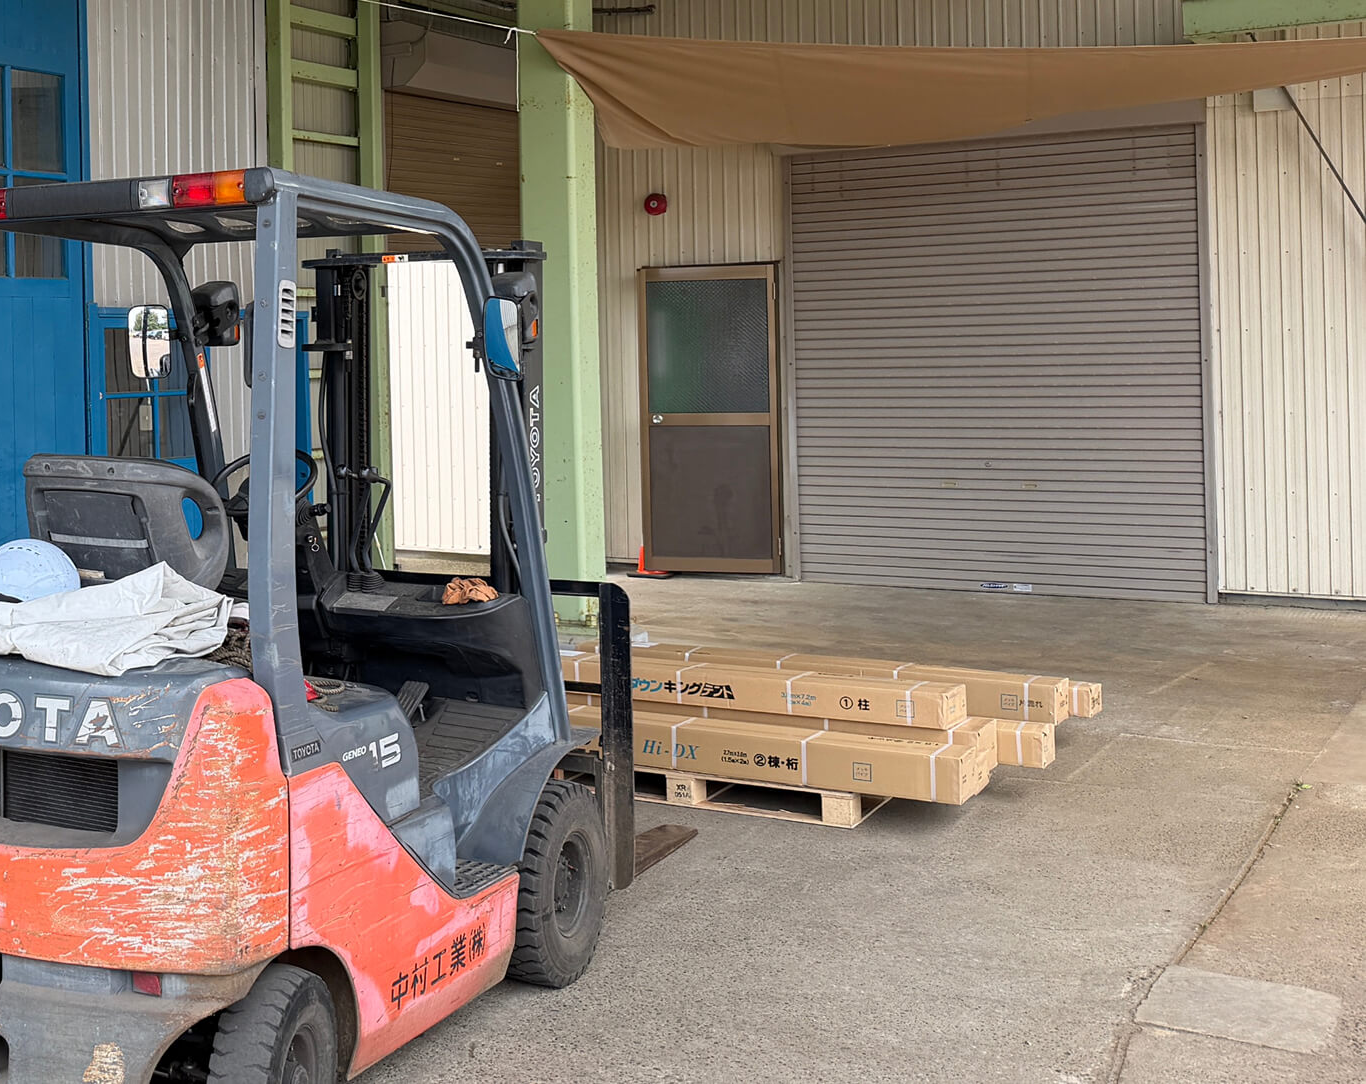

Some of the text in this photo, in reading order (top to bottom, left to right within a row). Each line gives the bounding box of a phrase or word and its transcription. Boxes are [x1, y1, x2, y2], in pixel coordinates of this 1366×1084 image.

[529, 384, 541, 502] OYOTA
[857, 698, 871, 711] 柱
[293, 742, 320, 761] TOYOTA
[342, 732, 401, 772] GENEO 15
